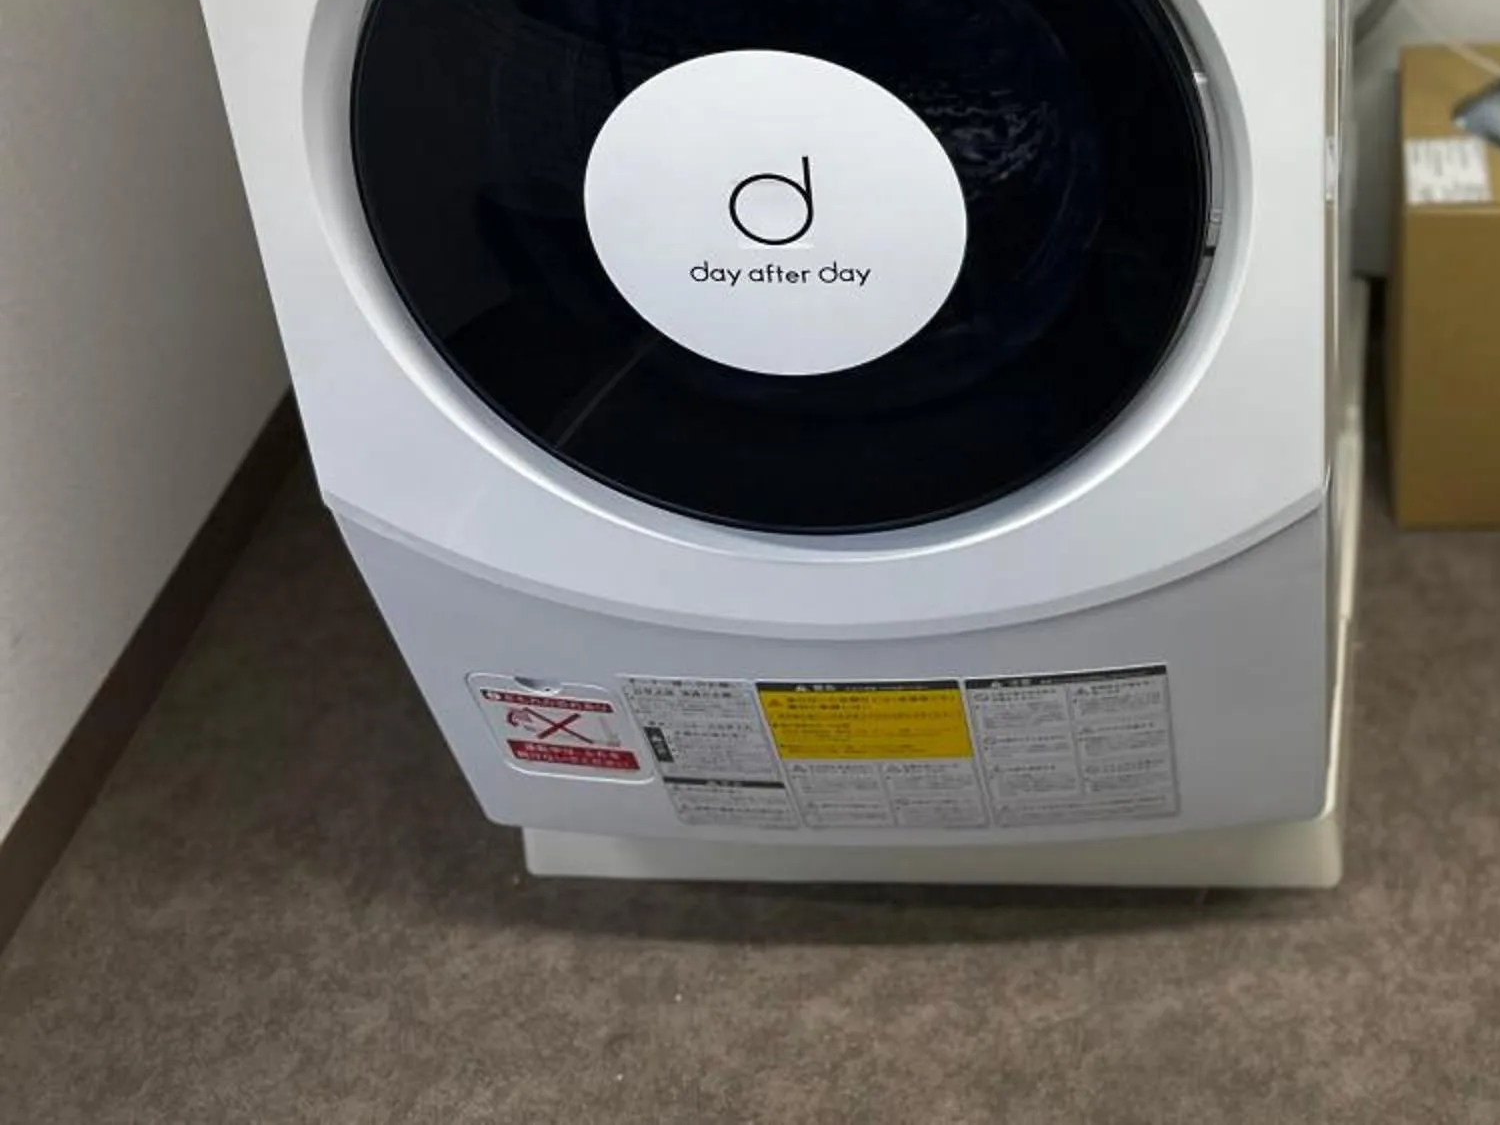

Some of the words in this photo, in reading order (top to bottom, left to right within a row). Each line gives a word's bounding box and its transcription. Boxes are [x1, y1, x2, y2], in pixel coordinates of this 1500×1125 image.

[689, 260, 741, 286] day
[748, 263, 810, 284] after
[817, 261, 872, 286] day
